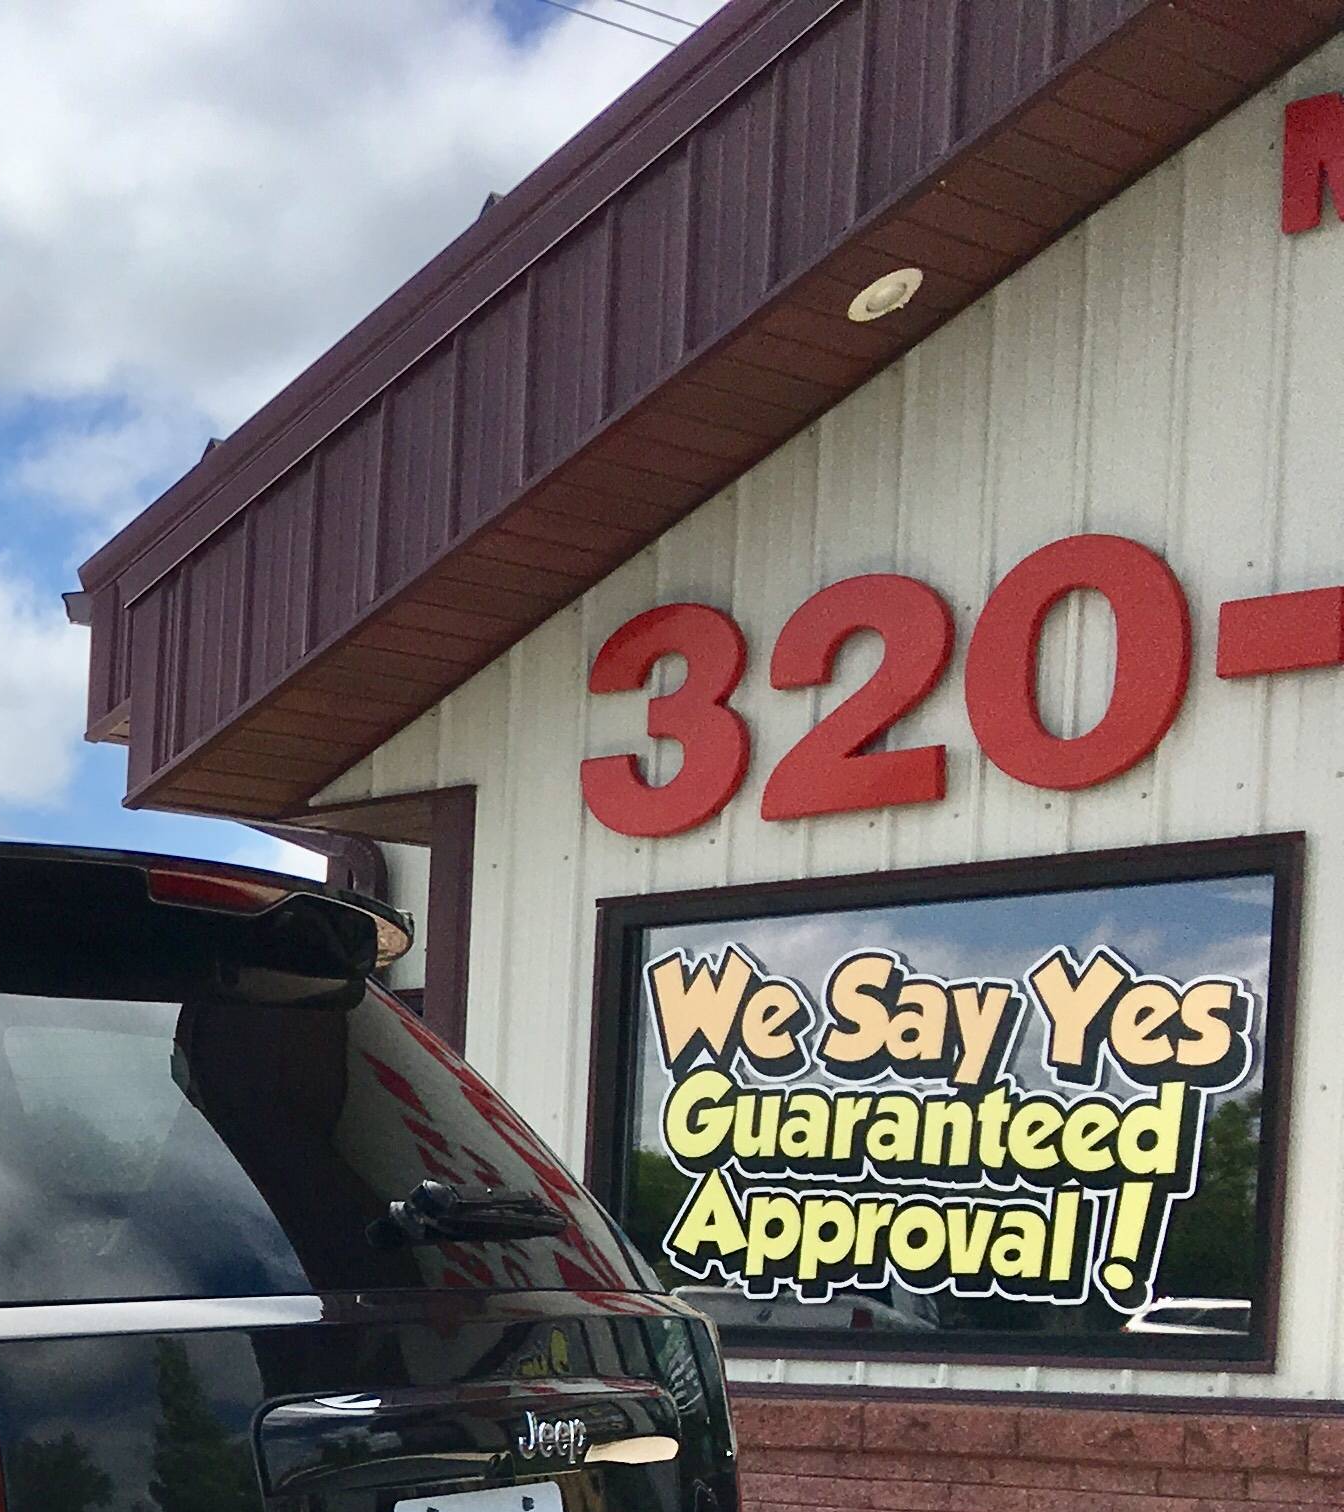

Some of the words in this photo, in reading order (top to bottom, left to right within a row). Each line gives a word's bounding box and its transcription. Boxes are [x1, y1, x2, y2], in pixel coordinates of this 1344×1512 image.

[650, 946, 800, 1065] We
[823, 954, 1012, 1085] Say
[1029, 950, 1236, 1068] Yes
[665, 1071, 1186, 1176] Guaranteed
[518, 1411, 587, 1464] Jeep
